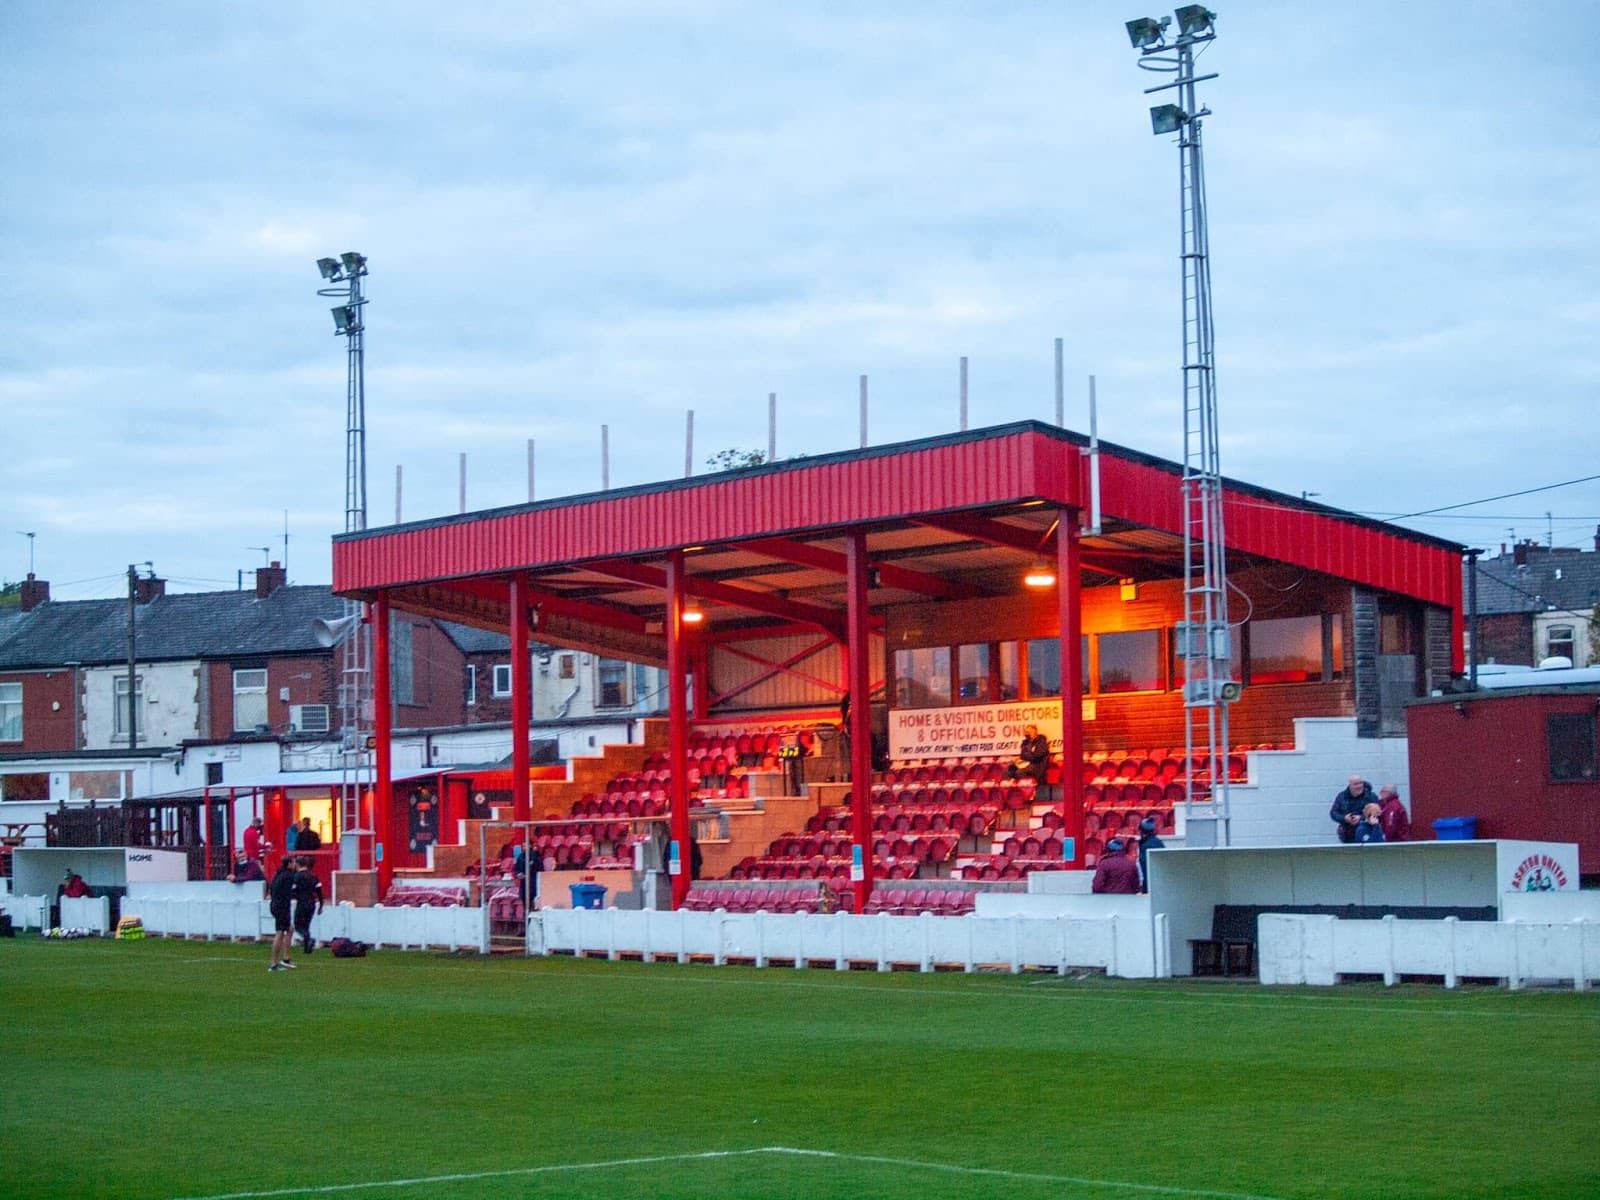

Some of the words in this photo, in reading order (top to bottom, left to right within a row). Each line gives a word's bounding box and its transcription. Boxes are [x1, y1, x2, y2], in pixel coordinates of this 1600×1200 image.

[899, 714, 931, 728] HOME
[935, 713, 942, 726] &
[944, 708, 994, 725] VISITING
[997, 706, 1060, 722] DIRECTORS
[918, 728, 925, 742] &
[930, 724, 996, 741] OFFICIALS
[1002, 723, 1034, 738] ONL
[899, 746, 914, 754] TWO
[914, 745, 932, 753] BACK
[934, 744, 954, 752] ROWS
[129, 854, 152, 862] HOME
[1511, 854, 1539, 889] ASHTON
[1542, 854, 1568, 887] UNITED
